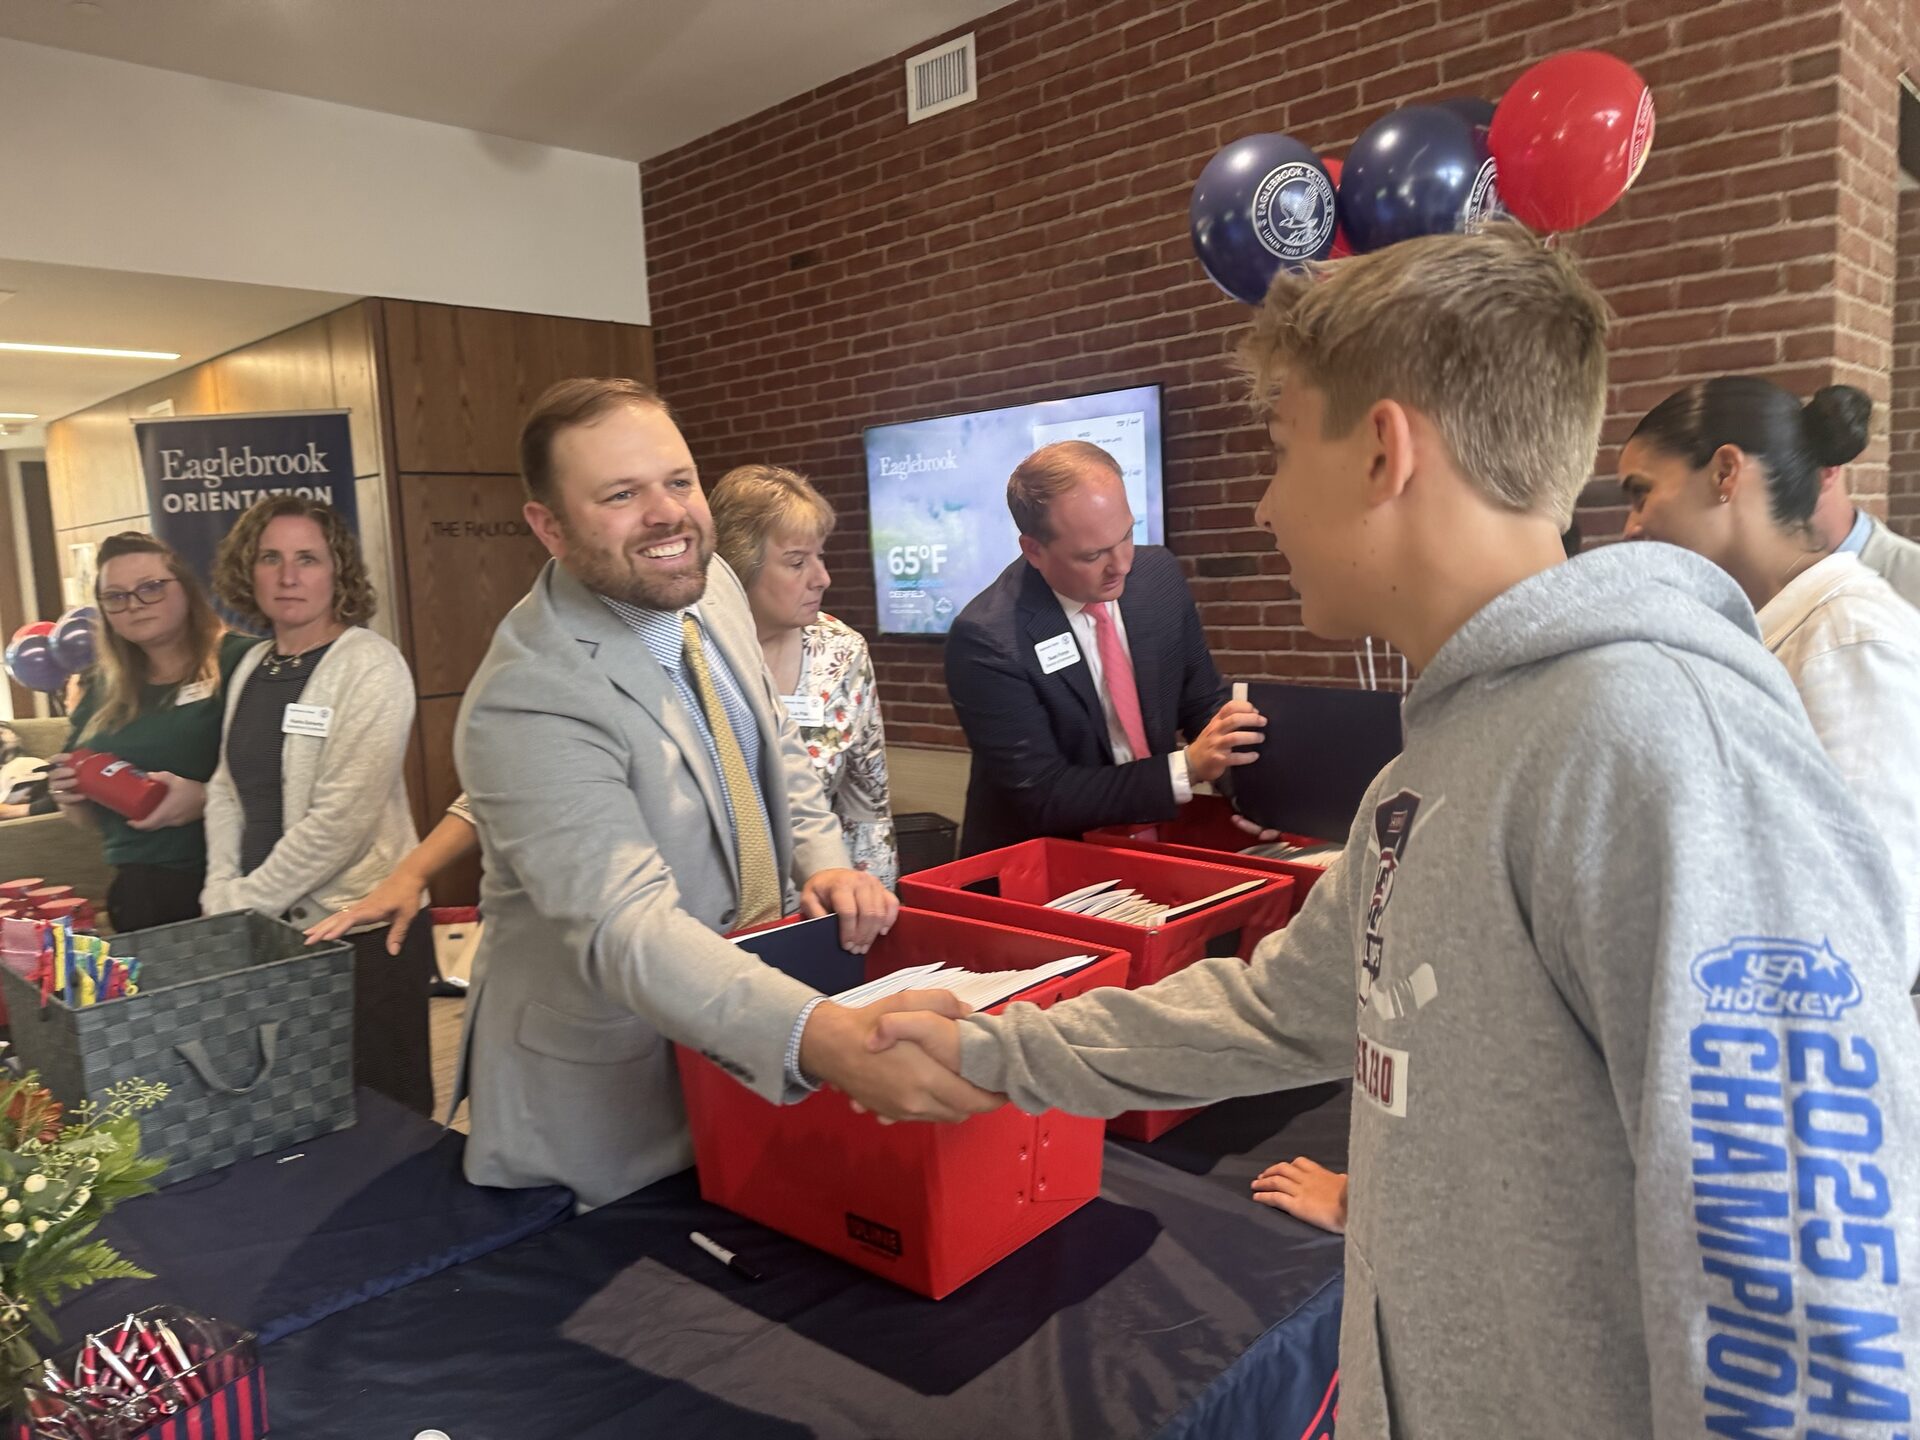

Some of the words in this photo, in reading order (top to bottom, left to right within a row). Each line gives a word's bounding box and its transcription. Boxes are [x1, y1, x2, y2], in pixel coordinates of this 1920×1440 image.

[1256, 166, 1304, 216] EAGLEBROOK
[160, 442, 330, 488] Eaglebrook
[880, 449, 958, 480] Eaglebrook
[888, 544, 948, 575] 65°F
[1741, 952, 1807, 985] USA
[1708, 984, 1842, 1018] HOCKEY
[1787, 1029, 1899, 1286] 2025
[1805, 1303, 1911, 1440] NA
